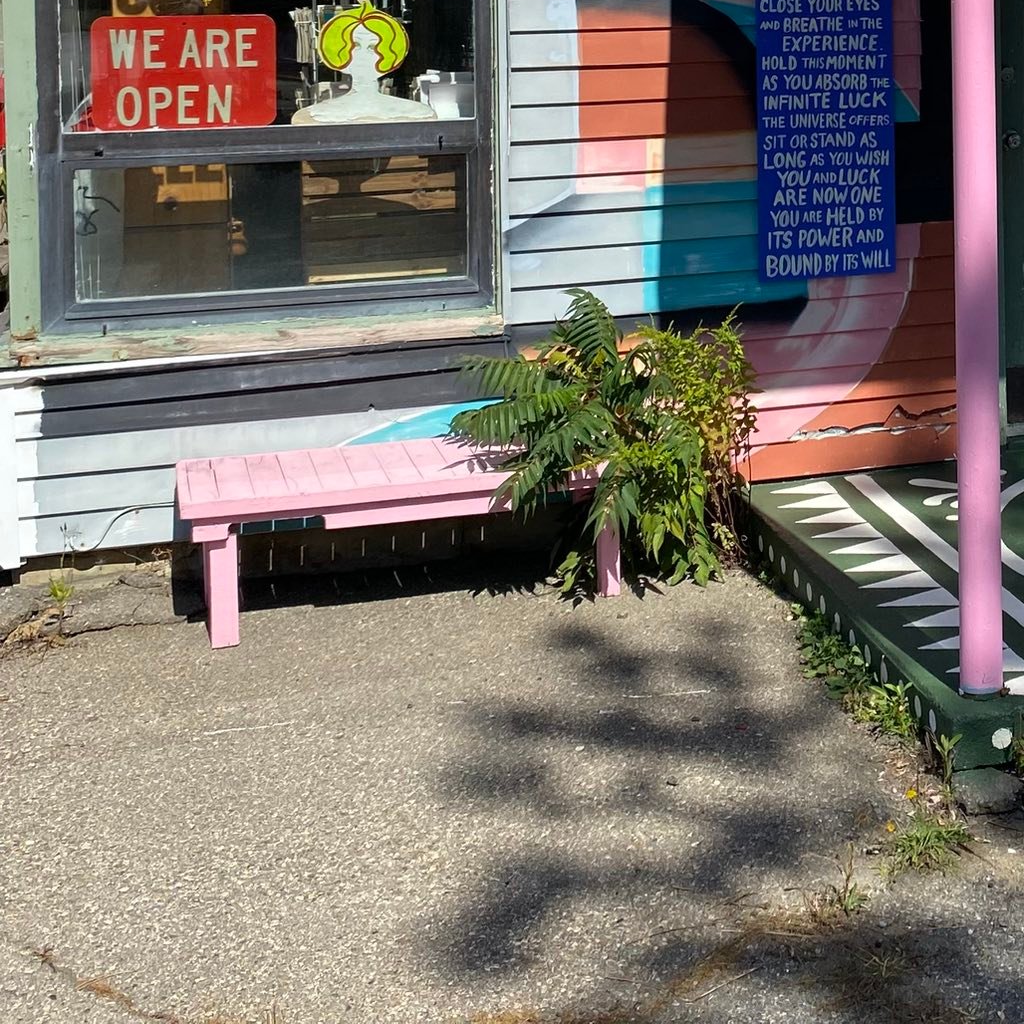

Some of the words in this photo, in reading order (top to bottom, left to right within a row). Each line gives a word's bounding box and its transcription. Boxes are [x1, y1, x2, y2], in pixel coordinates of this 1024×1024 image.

[760, 21, 779, 30] AND
[784, 17, 843, 32] BREATHE
[860, 18, 882, 29] THE
[109, 29, 166, 70] WE
[180, 28, 258, 68] ARE
[762, 56, 797, 70] HOLD
[802, 57, 824, 68] THIS
[826, 55, 887, 70] MOMENT
[763, 75, 778, 91] AS
[784, 74, 812, 90] YOU
[815, 73, 867, 90] ABSORB
[871, 78, 889, 88] THE
[116, 85, 232, 127] OPEN
[764, 92, 830, 110] INFINITE
[839, 92, 886, 108] LUCK
[763, 117, 785, 128] THE
[791, 113, 845, 128] UNIVERSE
[849, 115, 889, 125] OFFERS
[764, 135, 786, 150] SIT
[790, 135, 807, 148] OR
[811, 131, 855, 148] STAND
[860, 132, 877, 148] AS
[764, 151, 806, 169] LONG
[810, 153, 824, 165] AS
[830, 152, 852, 165] YOU
[856, 150, 889, 165] WISH
[777, 170, 811, 187] YOU
[813, 172, 836, 183] AND
[839, 168, 880, 185] LUCK
[774, 189, 807, 206] ARE
[813, 187, 848, 204] NOW
[851, 186, 881, 204] ONE
[770, 210, 799, 227] YOU
[803, 211, 822, 222] ARE
[827, 207, 864, 225] HELD
[869, 208, 883, 220] BY
[769, 231, 792, 249] ITS
[799, 227, 852, 248] POWER
[857, 229, 884, 243] AND
[766, 253, 822, 277] BOUND
[825, 254, 839, 272] BY
[843, 254, 858, 270] ITS
[861, 249, 890, 268] WILL
